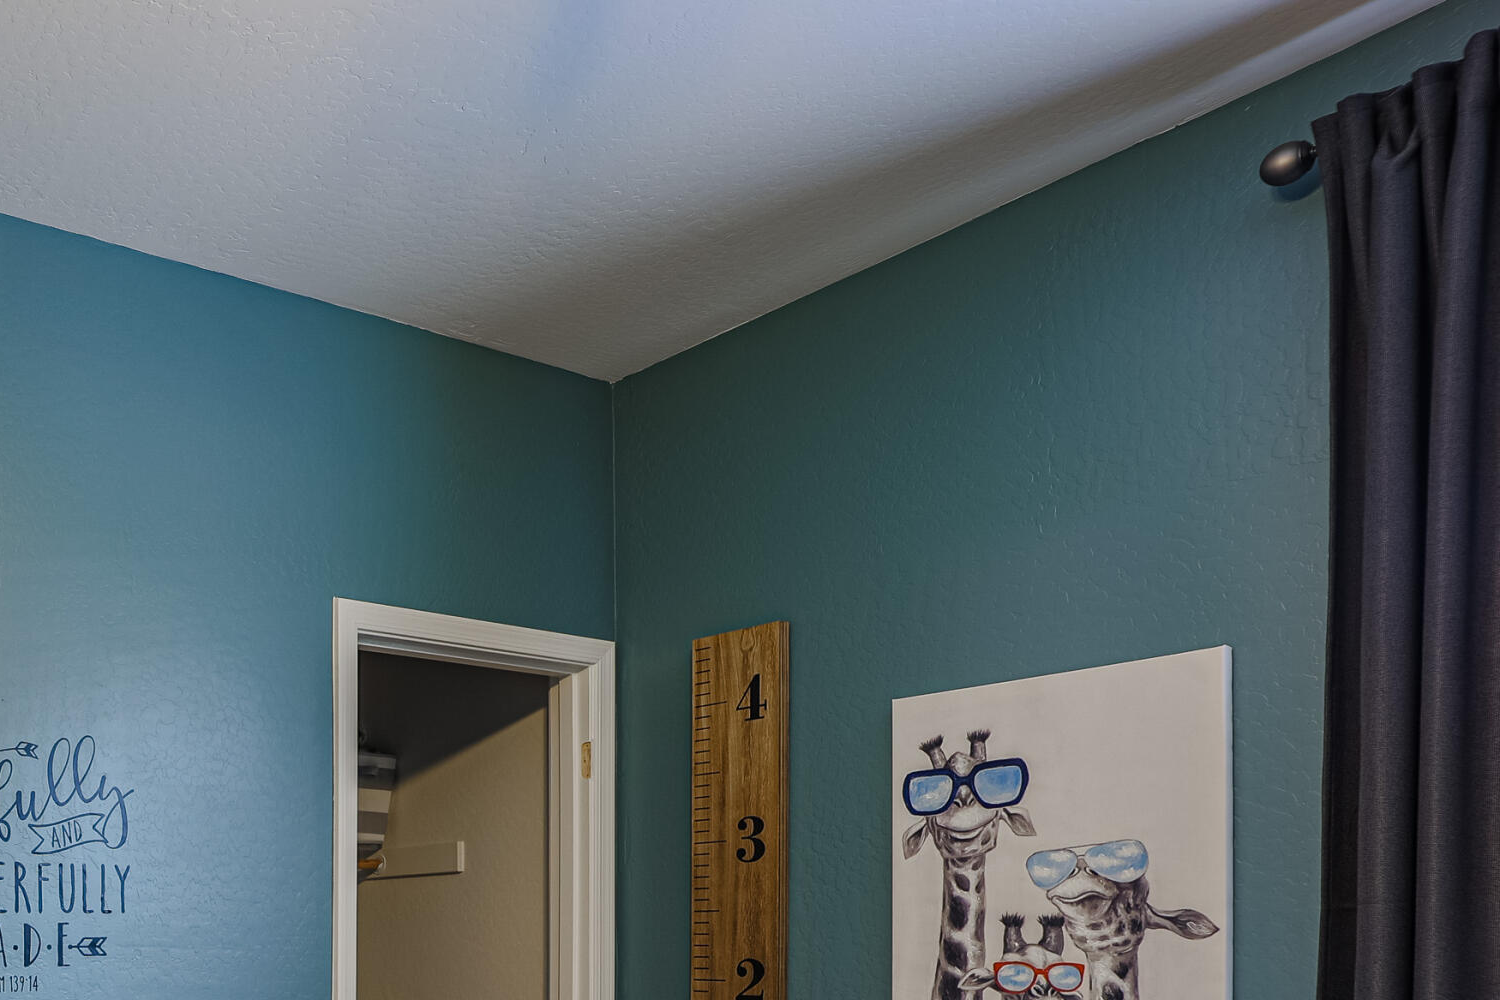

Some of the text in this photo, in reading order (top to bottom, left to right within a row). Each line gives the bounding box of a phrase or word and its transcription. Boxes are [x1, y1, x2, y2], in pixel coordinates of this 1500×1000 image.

[735, 672, 768, 722] 4
[51, 820, 83, 848] AND
[735, 815, 767, 863] 3
